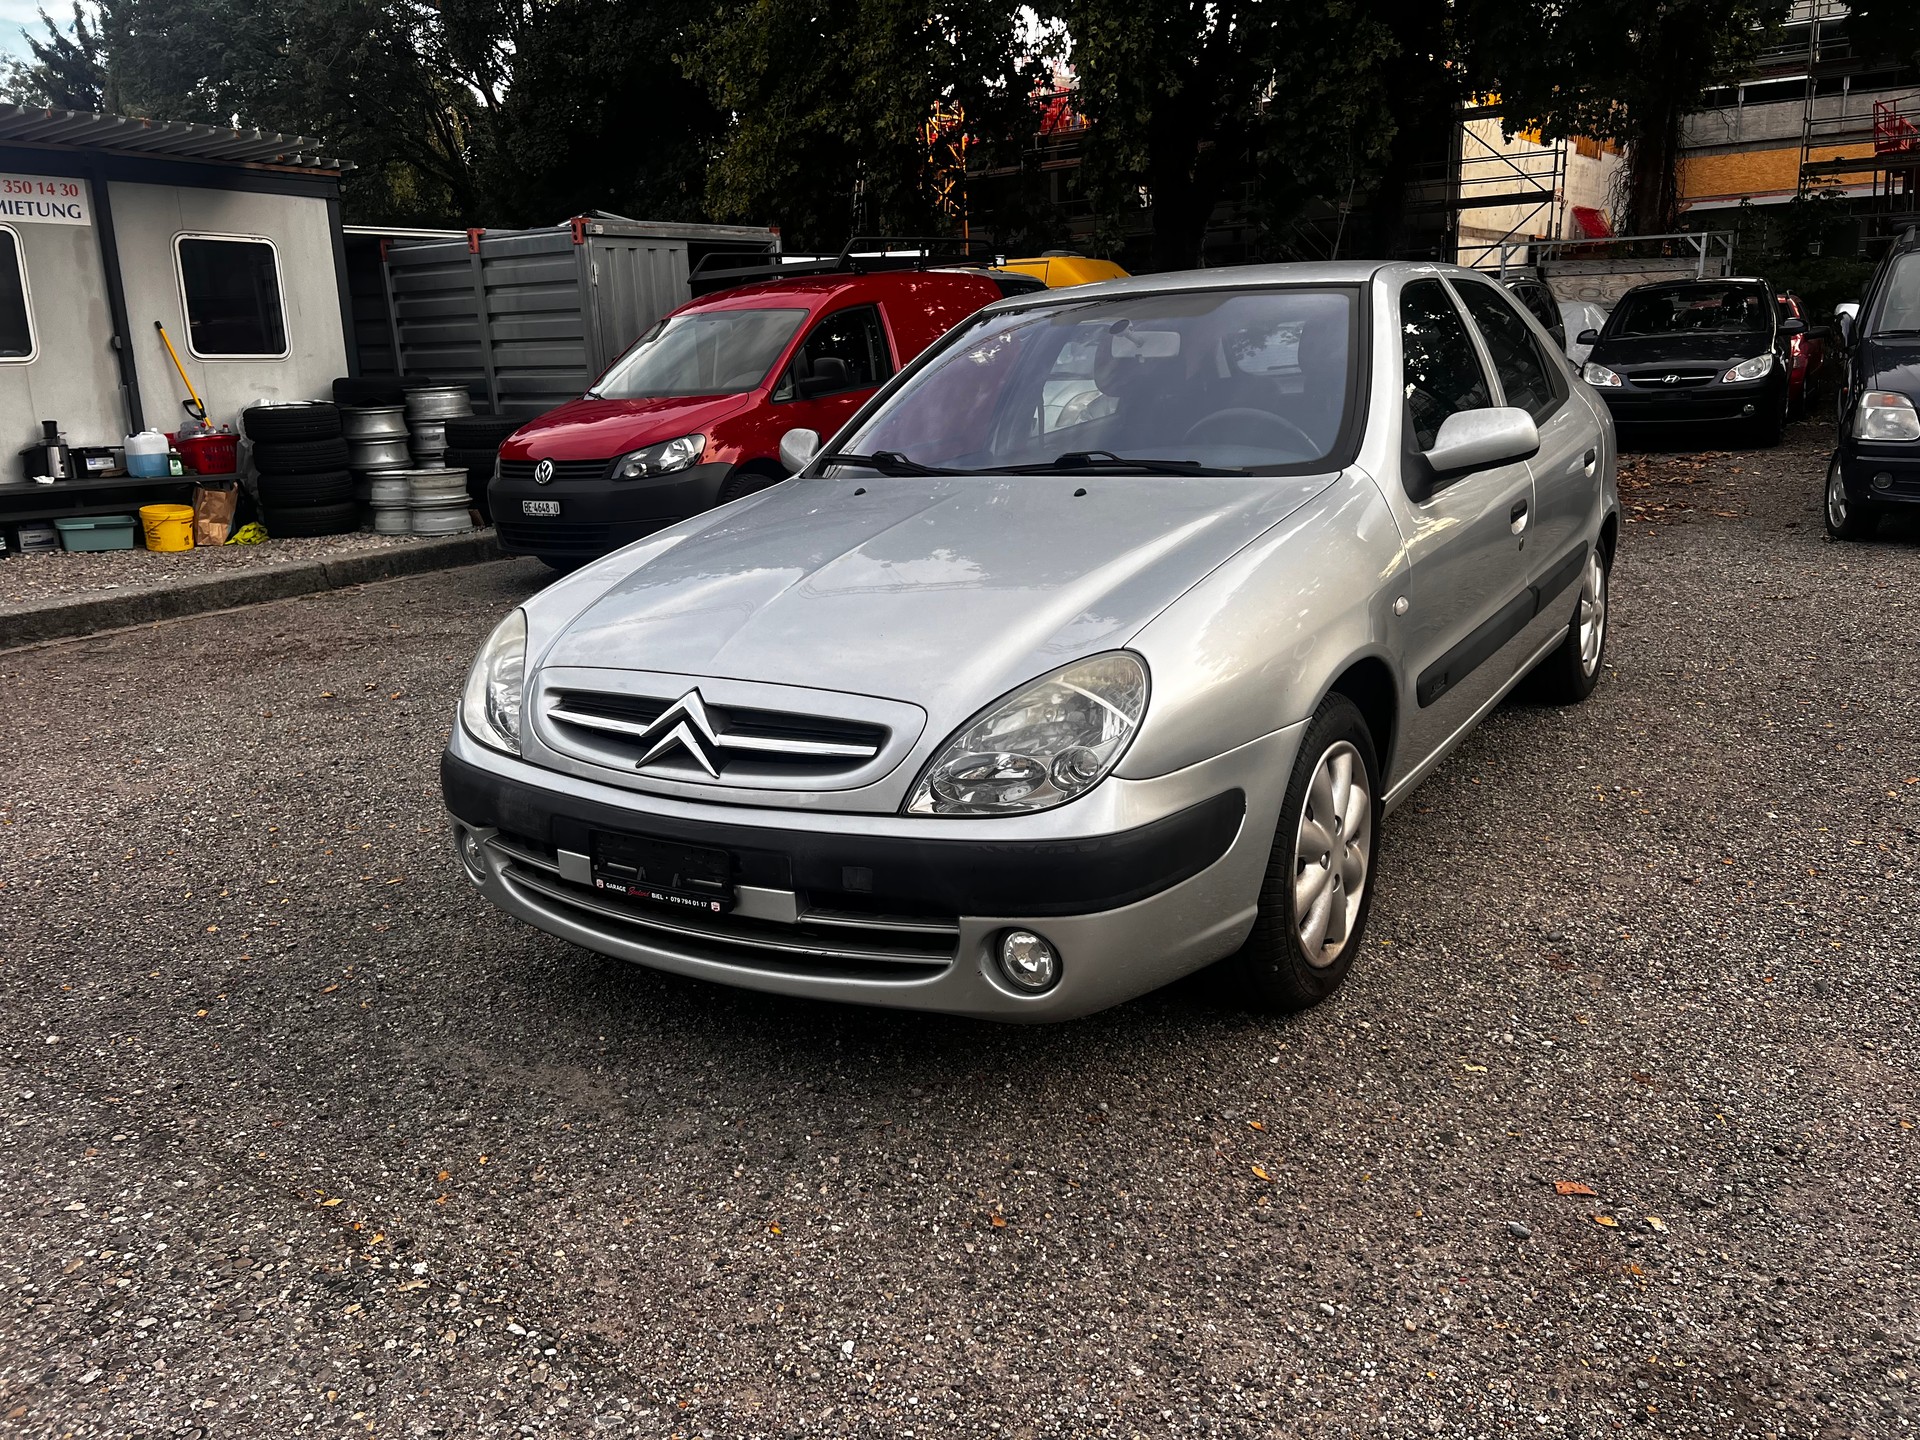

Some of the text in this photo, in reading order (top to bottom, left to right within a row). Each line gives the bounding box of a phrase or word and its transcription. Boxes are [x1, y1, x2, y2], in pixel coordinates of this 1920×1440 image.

[3, 179, 79, 197] 350 14 30
[605, 882, 627, 893] GARAGE
[651, 892, 664, 900] BIEL
[670, 896, 681, 904] 079
[681, 898, 692, 906] 794
